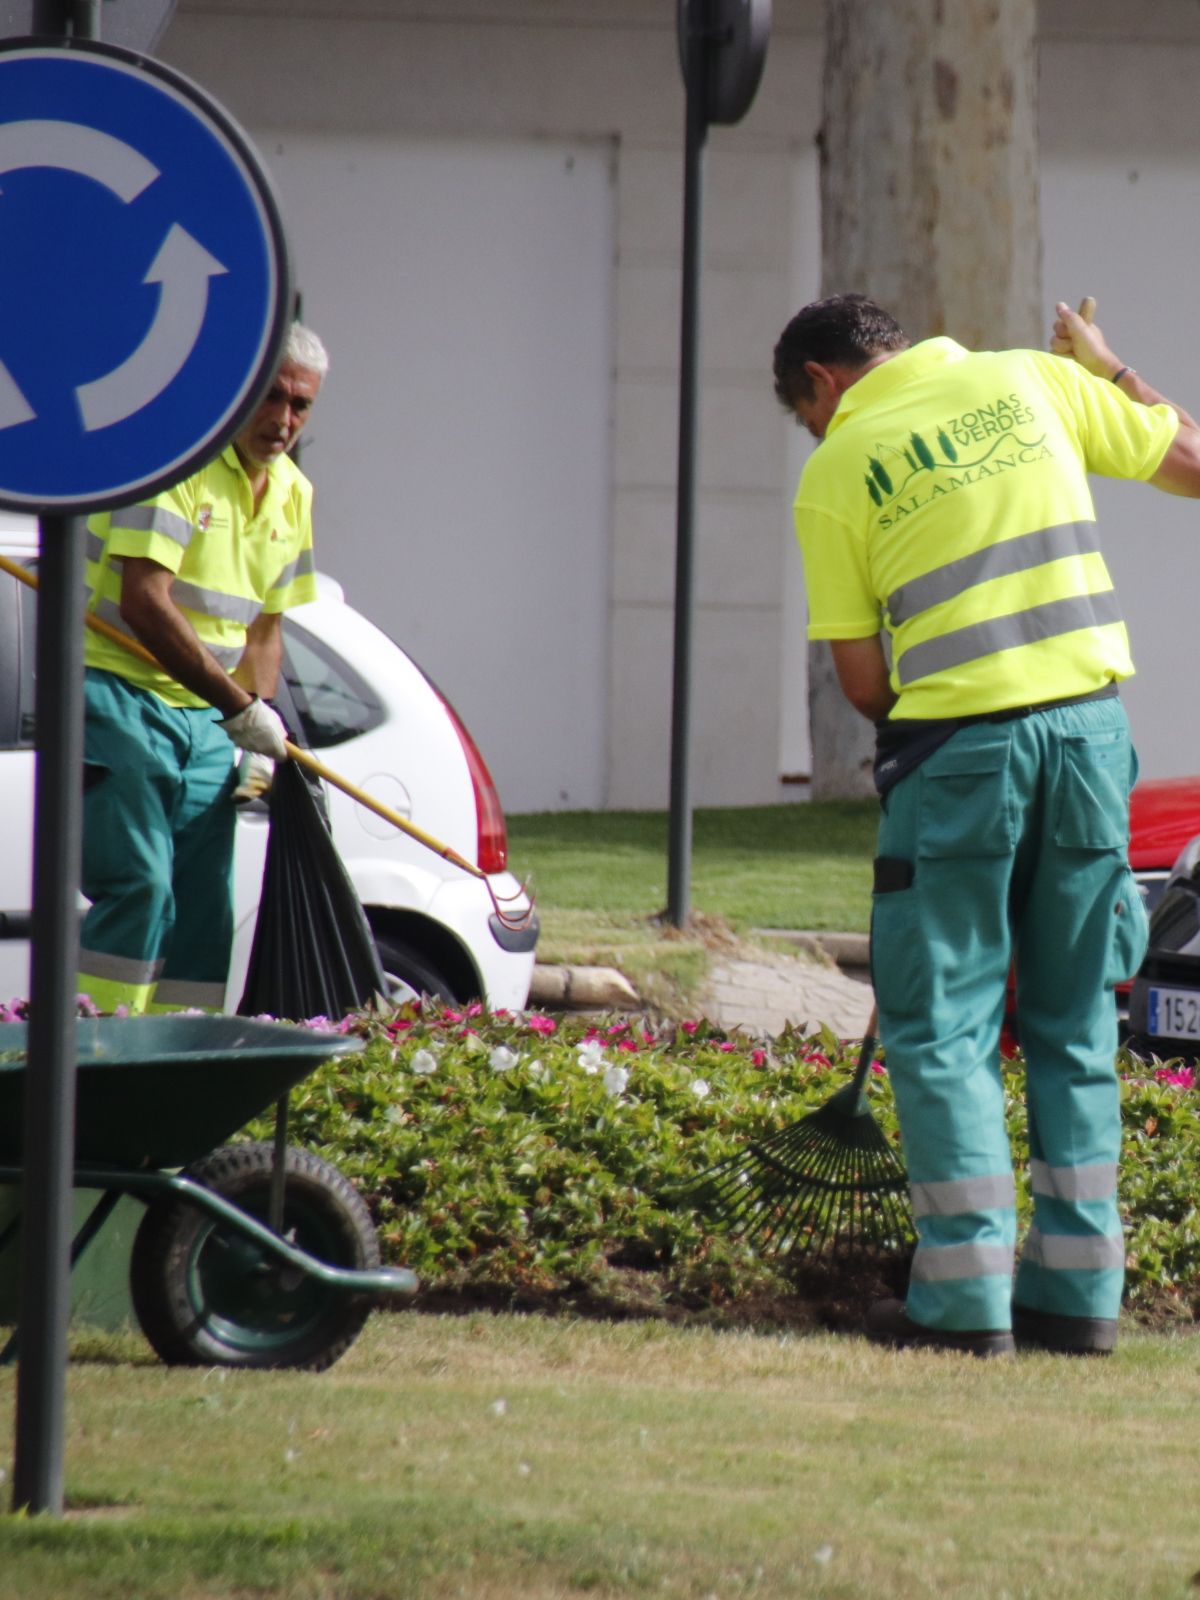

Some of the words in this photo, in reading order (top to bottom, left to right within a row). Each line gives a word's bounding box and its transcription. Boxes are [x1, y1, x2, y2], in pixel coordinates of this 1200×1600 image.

[948, 394, 1021, 435] ZONAS
[955, 407, 1035, 446] VERDES
[879, 445, 1053, 530] SALAMANCA
